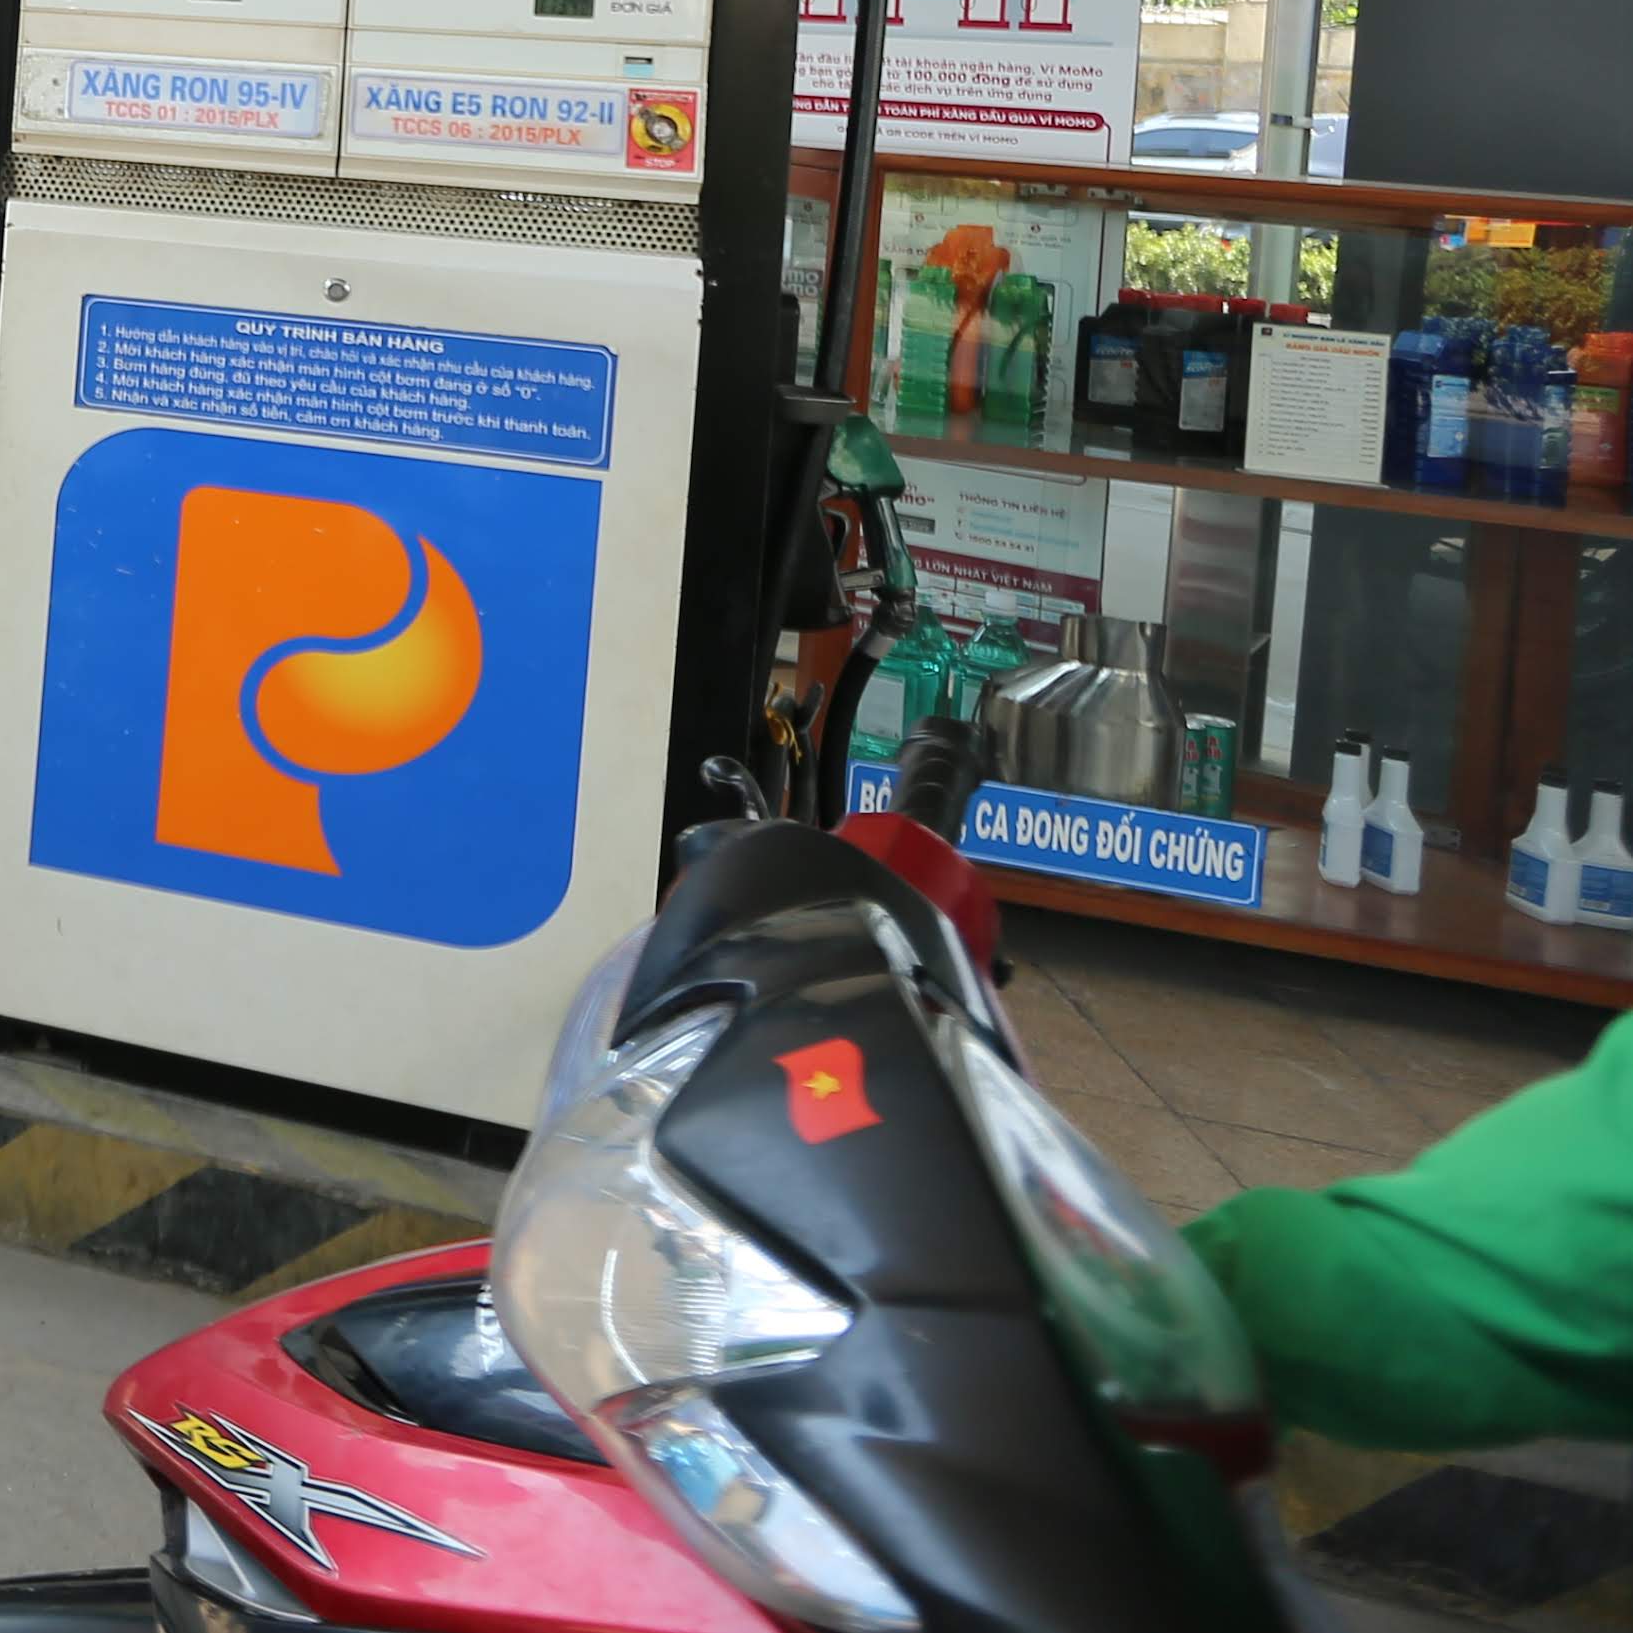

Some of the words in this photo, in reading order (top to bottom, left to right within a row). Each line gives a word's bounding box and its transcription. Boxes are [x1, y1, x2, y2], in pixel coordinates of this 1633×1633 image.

[1058, 66, 1103, 78] MoMo
[82, 67, 161, 101] XĂNG
[170, 76, 229, 106] RON
[238, 81, 308, 111] 95-IV
[105, 100, 152, 119] TCCS
[157, 105, 177, 122] 01
[194, 108, 280, 129] 2015/PLX
[365, 84, 442, 114] XĂNG
[451, 92, 481, 117] E5
[491, 95, 548, 120] RON
[558, 100, 614, 125] 92-II
[391, 117, 441, 137] TCCS
[448, 122, 471, 139] 06
[489, 124, 582, 146] 2015/PLX
[1055, 117, 1097, 129] MOMO
[236, 319, 276, 336] QUY
[281, 323, 337, 343] TRÌNH
[342, 331, 383, 348] BÁN
[387, 334, 444, 354] HÀNG
[1023, 579, 1052, 594] NAM
[975, 798, 1009, 843] CA
[1015, 808, 1088, 855] ĐONG
[1096, 812, 1142, 863] ĐỐI
[1149, 825, 1245, 883] CHỨNG
